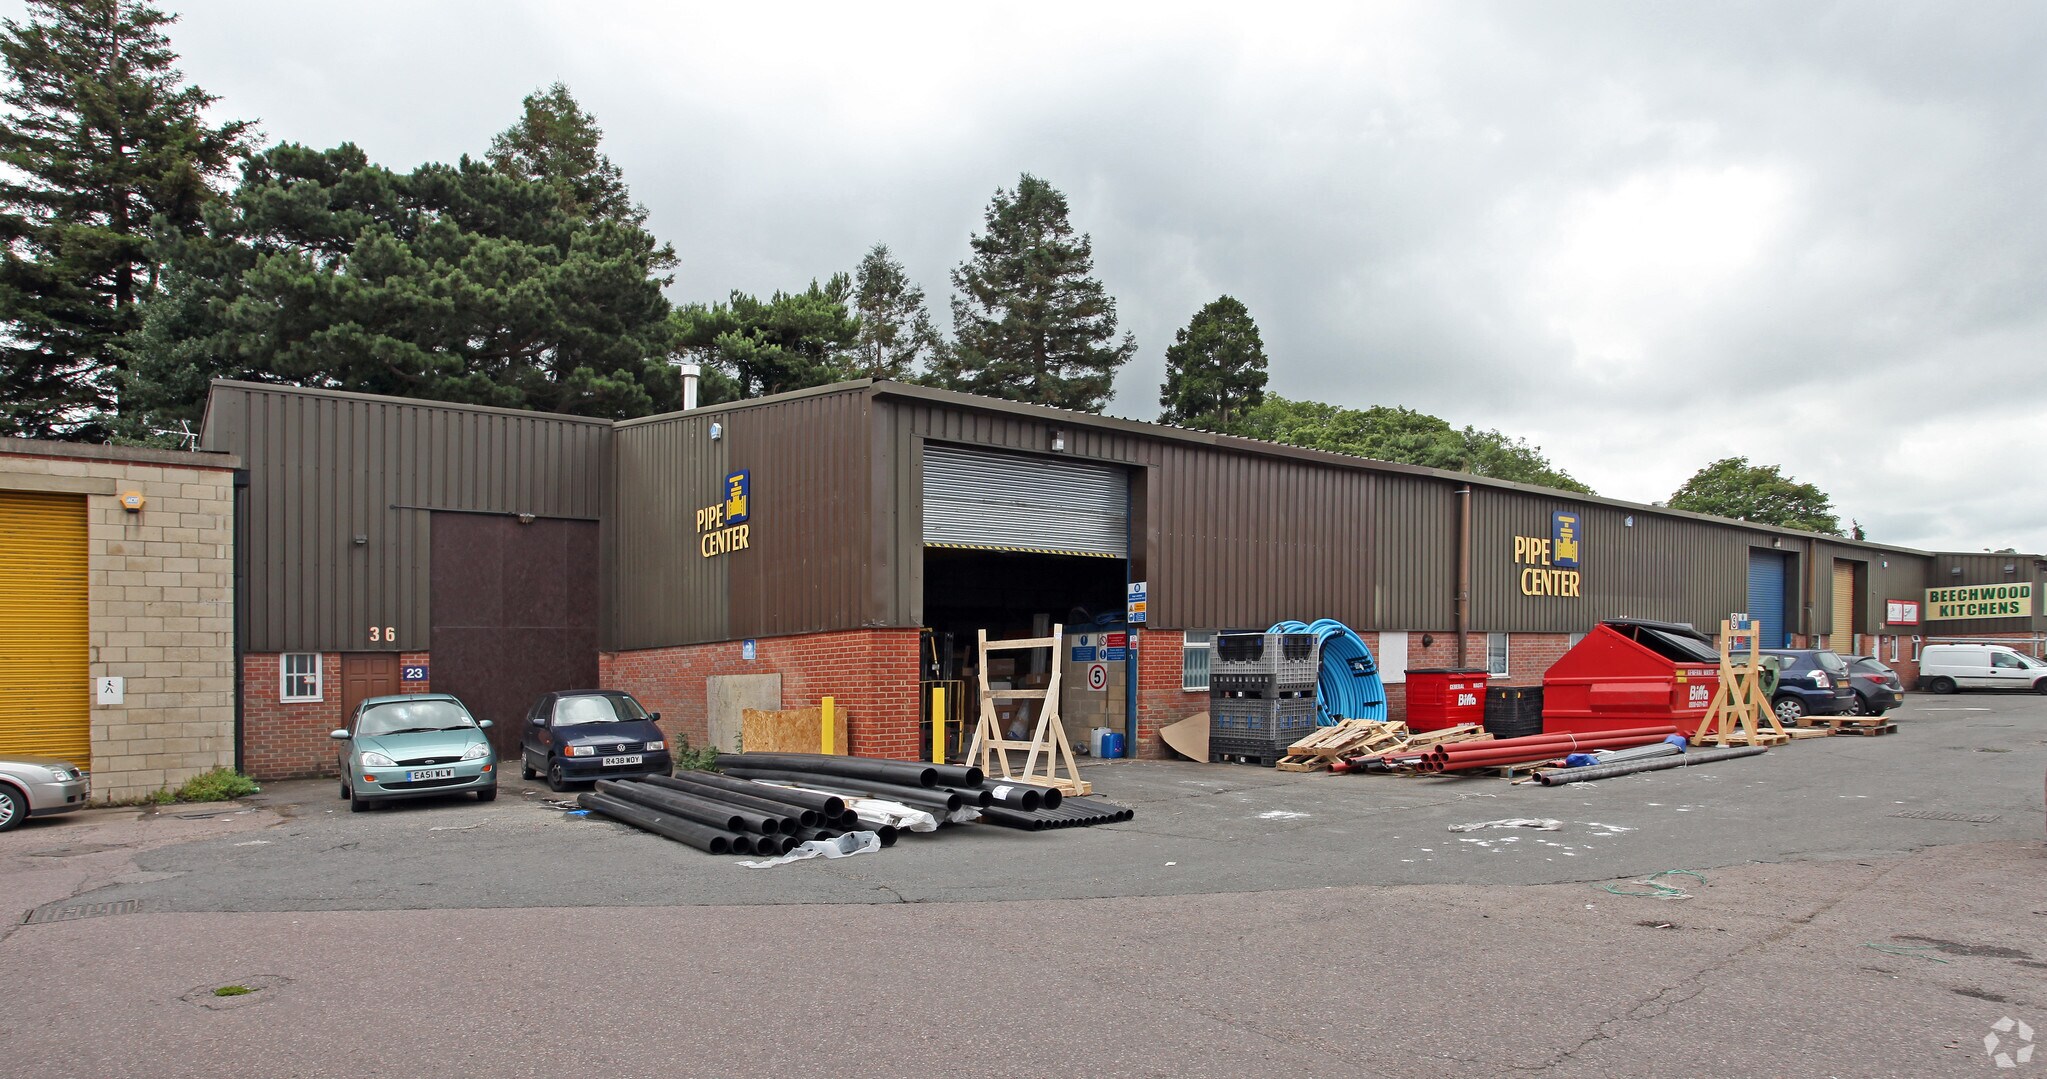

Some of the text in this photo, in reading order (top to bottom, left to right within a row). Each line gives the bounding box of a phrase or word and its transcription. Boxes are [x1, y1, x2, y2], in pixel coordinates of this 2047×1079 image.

[696, 503, 724, 533] PIPE
[701, 524, 749, 558] CENTER
[1514, 535, 1550, 566] PIPE
[1521, 568, 1580, 597] CENTER
[1929, 586, 2030, 603] BEECHWOOD
[1939, 601, 2020, 617] KITCHENS
[406, 668, 423, 679] 23
[1094, 670, 1101, 684] 5
[1458, 694, 1476, 706] Biffa
[1689, 685, 1708, 700] Biffa
